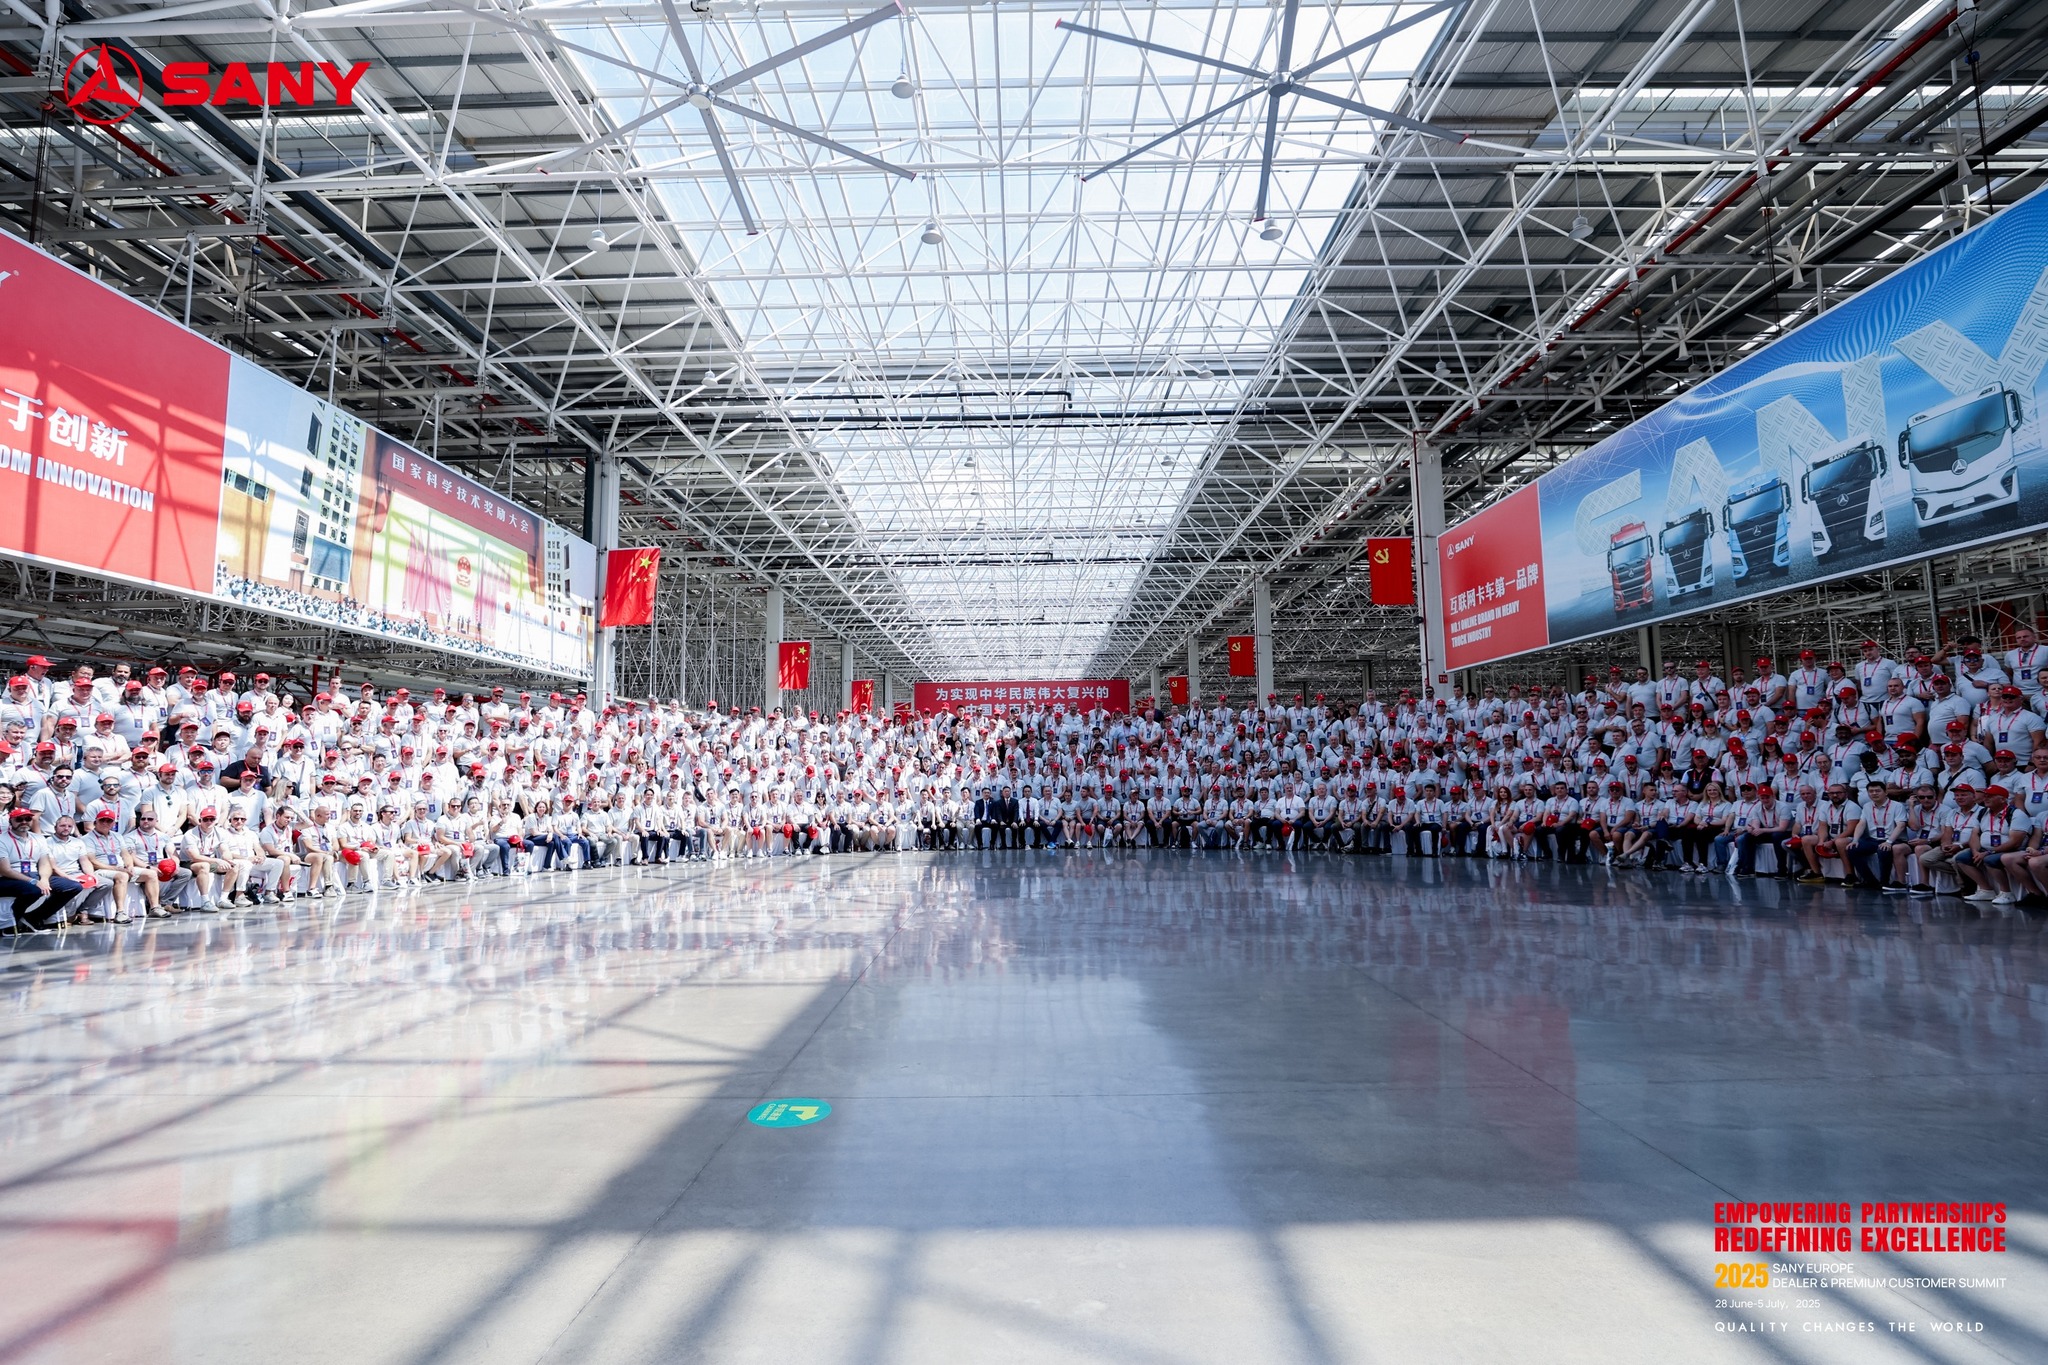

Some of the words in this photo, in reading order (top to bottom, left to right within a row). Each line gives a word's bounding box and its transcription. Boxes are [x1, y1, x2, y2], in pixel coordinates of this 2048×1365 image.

[1, 388, 129, 466] 于创新
[36, 456, 155, 512] INNOVATION
[392, 452, 529, 534] 国家科学技术奖励大会
[1455, 535, 1475, 553] SANY
[1450, 563, 1539, 615] 互联网卡车第一品牌
[935, 685, 1110, 701] 为实现中华民族伟大复兴的
